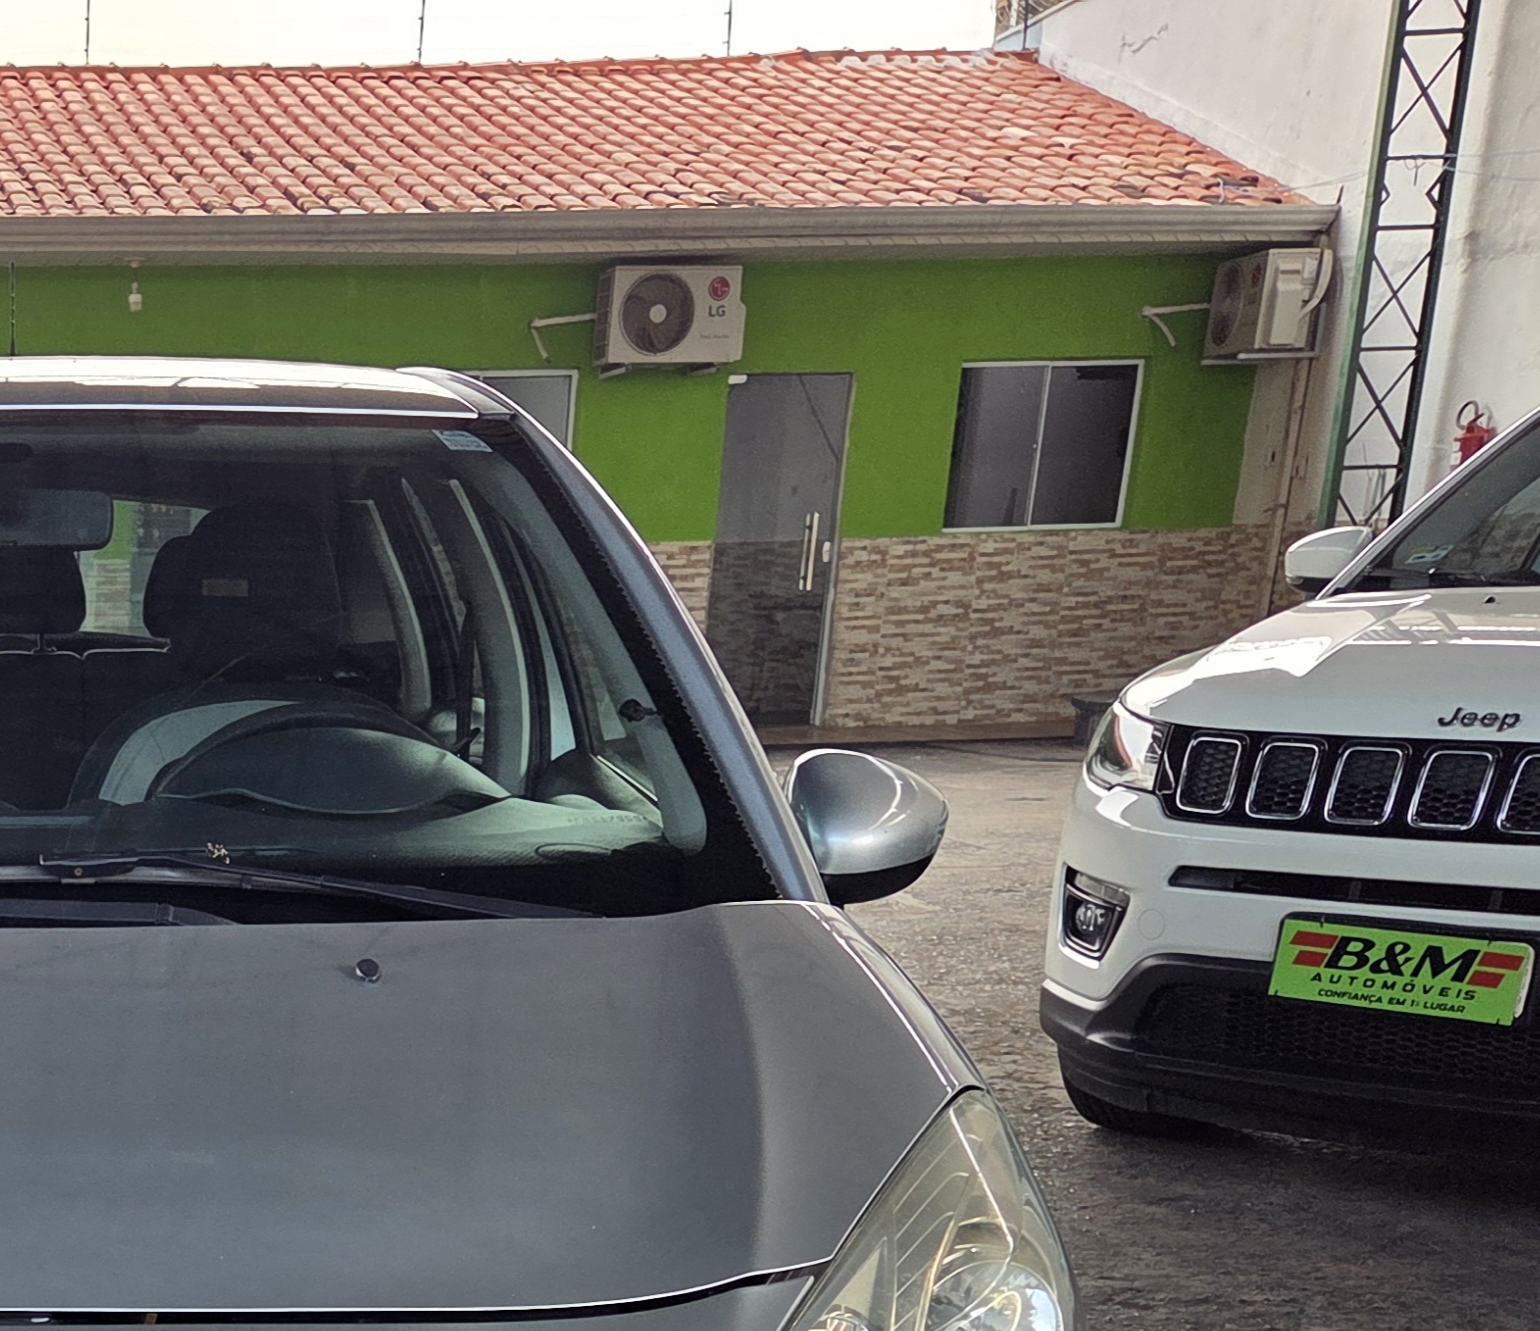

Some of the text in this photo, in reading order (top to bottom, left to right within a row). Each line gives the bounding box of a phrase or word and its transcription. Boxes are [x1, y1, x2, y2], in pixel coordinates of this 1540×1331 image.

[708, 304, 726, 318] LG
[1437, 706, 1521, 733] Jeep
[1323, 935, 1481, 983] B&M
[1310, 972, 1478, 1001] AUTOMÓVEIS
[1317, 988, 1383, 1005] CONFIANÇA
[1387, 996, 1406, 1007] EM
[1423, 1001, 1466, 1014] LUGAR
